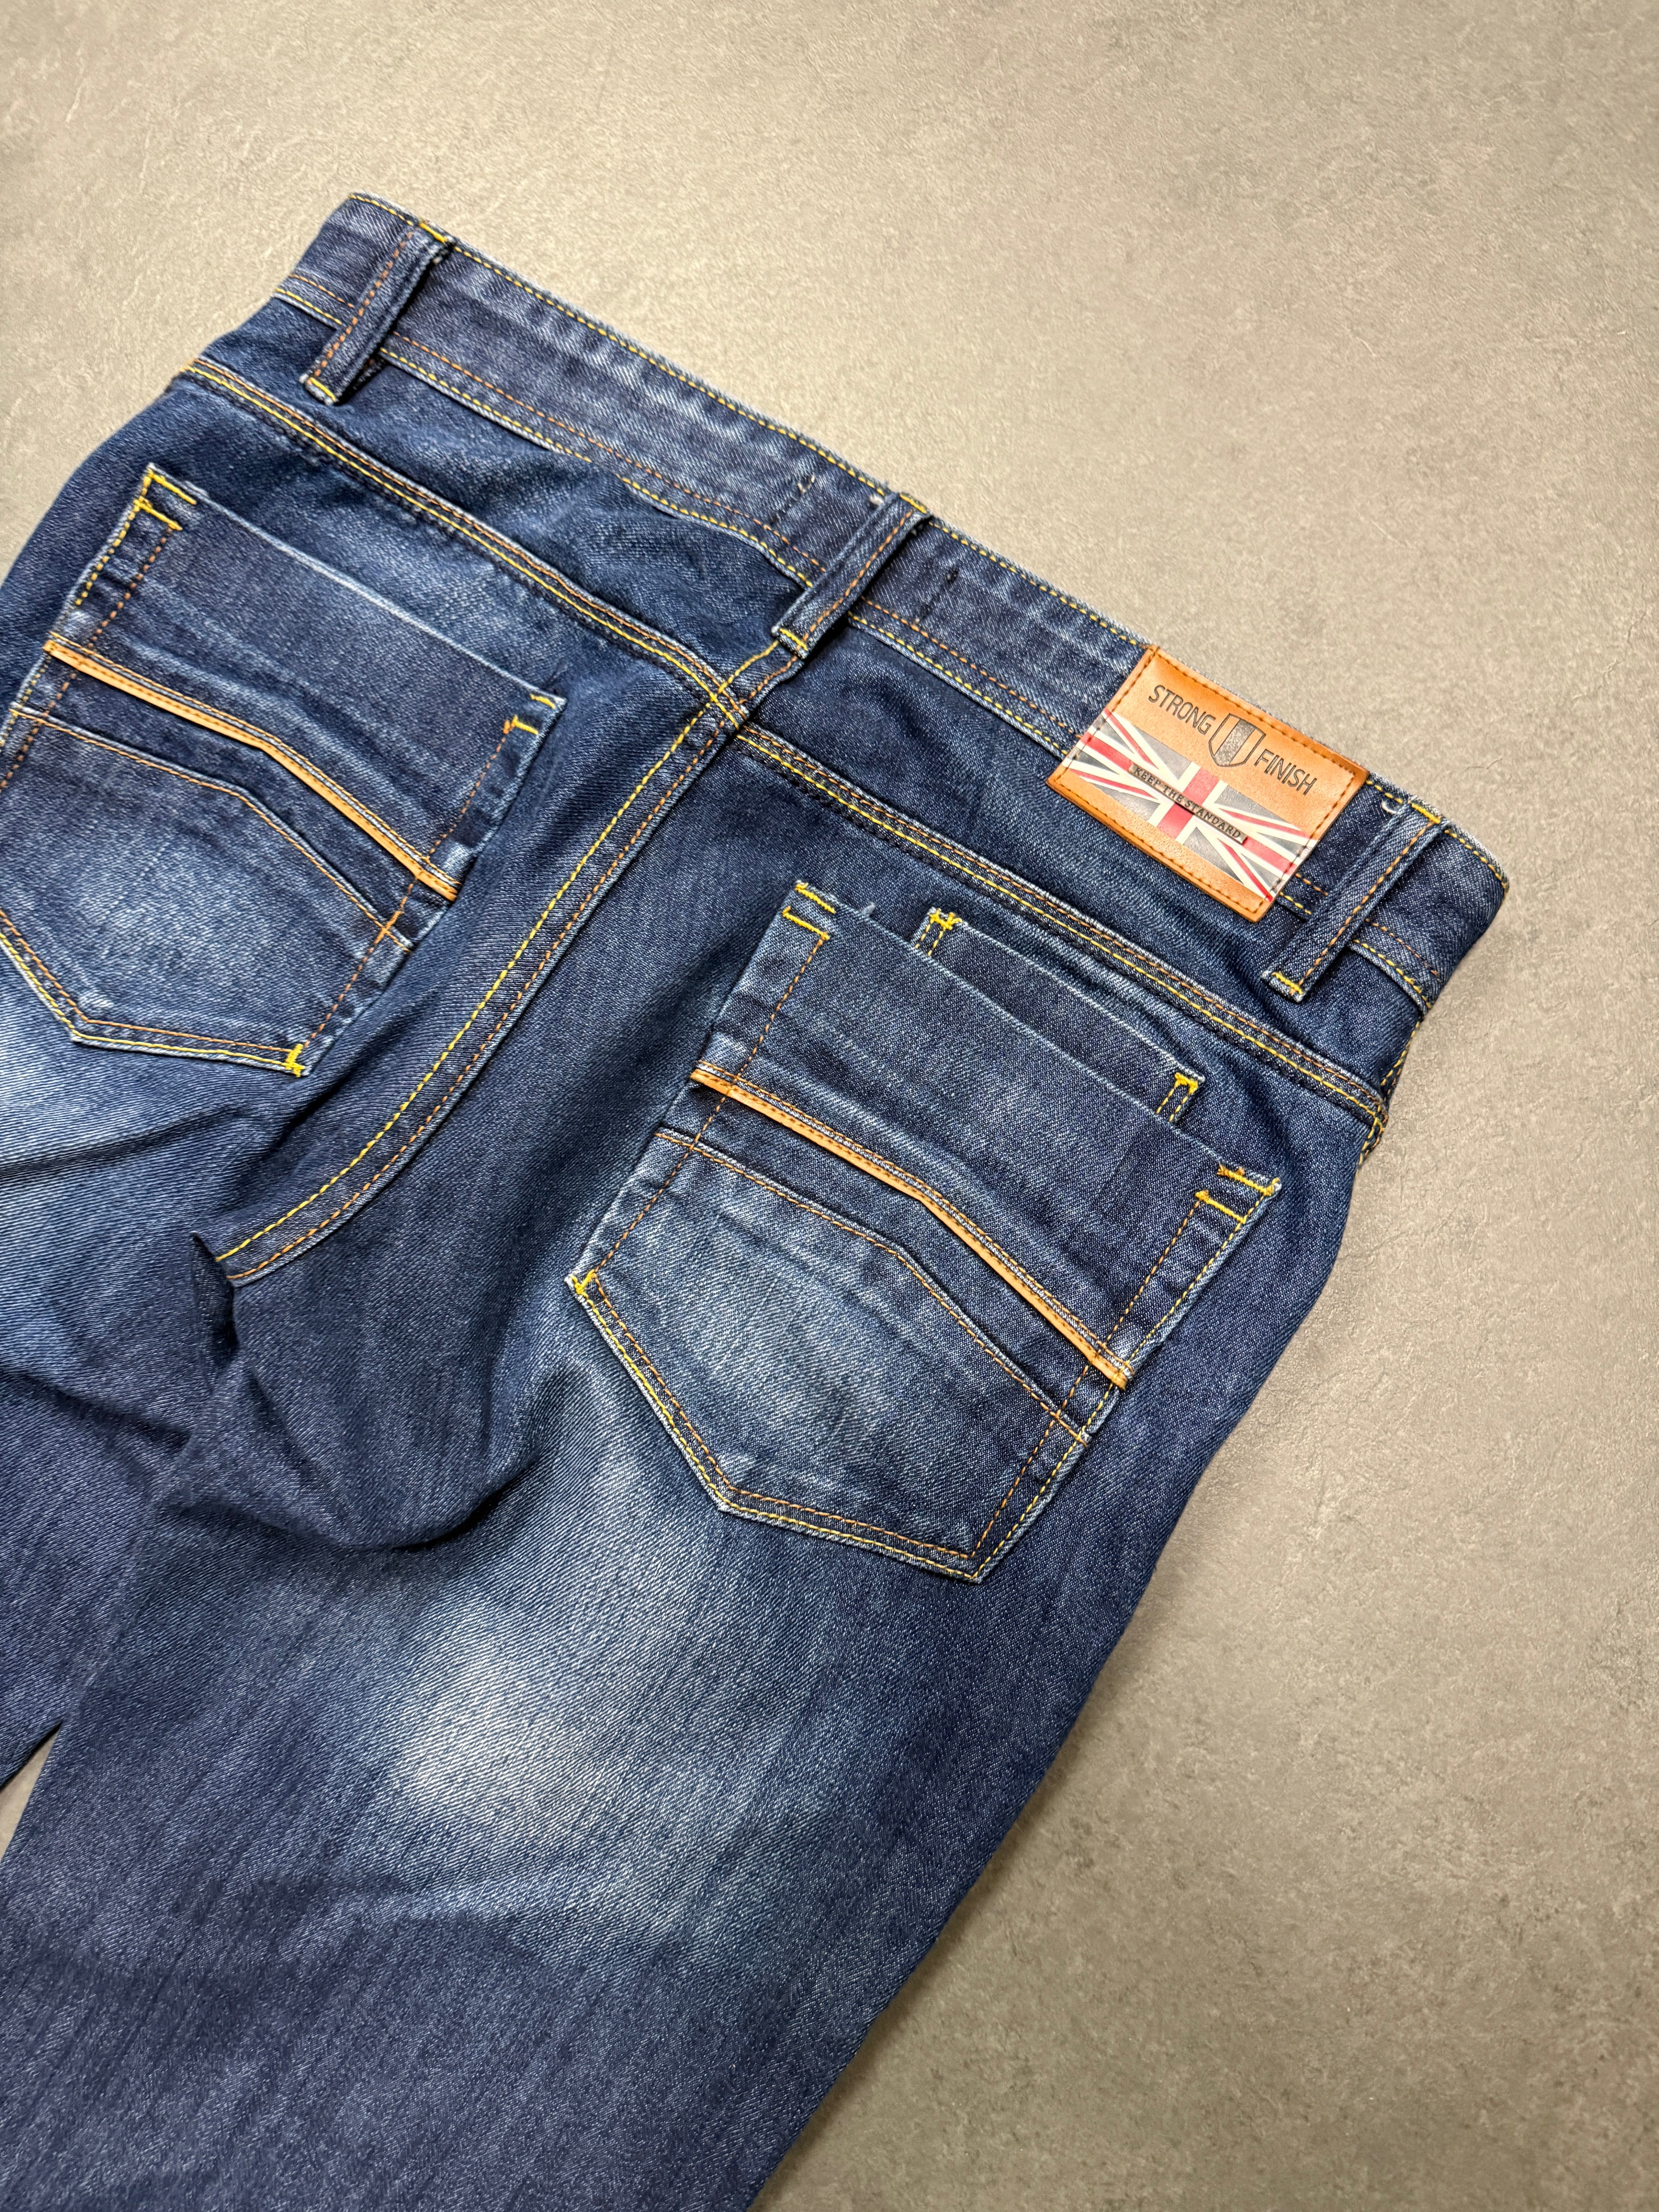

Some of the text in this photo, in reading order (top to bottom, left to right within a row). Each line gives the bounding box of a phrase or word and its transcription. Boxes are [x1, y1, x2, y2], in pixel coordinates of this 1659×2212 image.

[1149, 685, 1317, 796] STRONG FINISH
[1134, 767, 1241, 838] KEEP THE STANDARD
